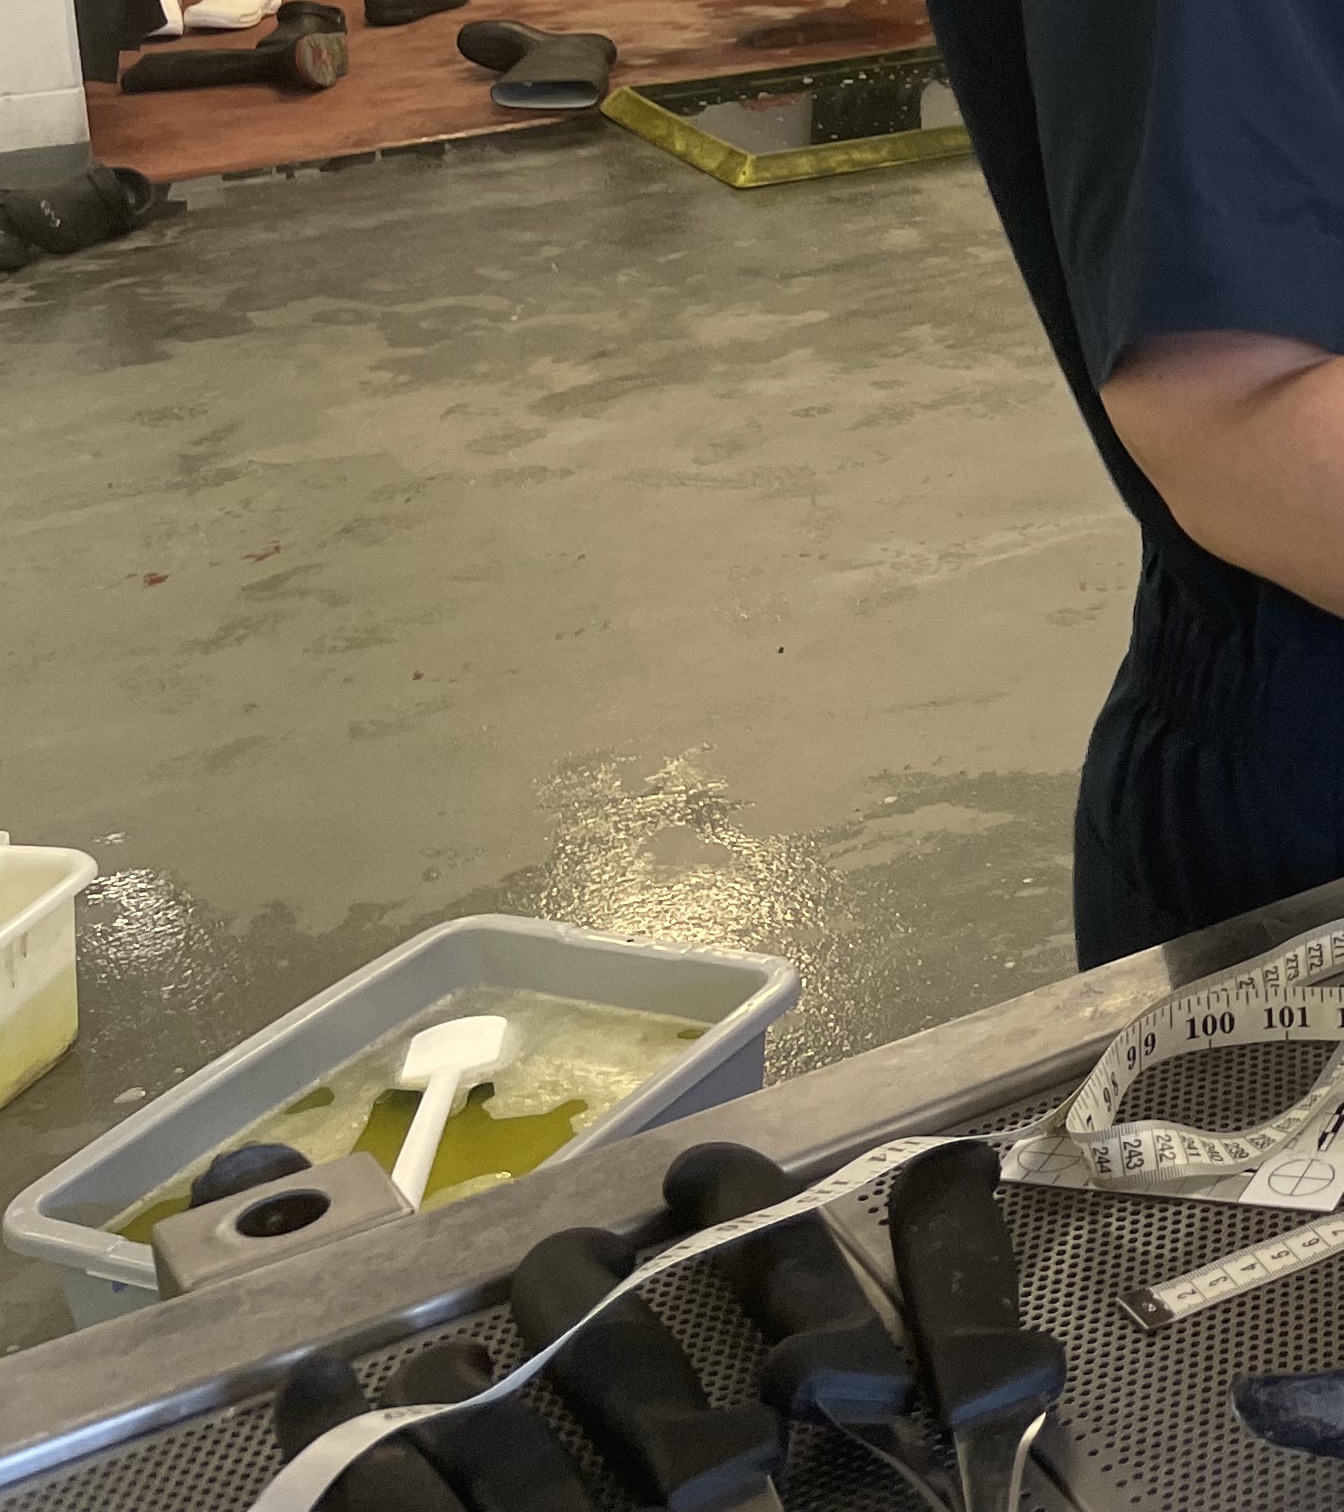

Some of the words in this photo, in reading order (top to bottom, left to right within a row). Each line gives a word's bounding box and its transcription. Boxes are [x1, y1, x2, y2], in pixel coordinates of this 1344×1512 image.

[1287, 953, 1299, 982] 273
[1309, 943, 1323, 971] 272
[1186, 1011, 1236, 1040] 100
[1263, 1006, 1311, 1030] 101
[1092, 1146, 1112, 1175] 244
[1122, 1138, 1145, 1171] 243
[1155, 1133, 1177, 1164] 242
[1182, 1135, 1202, 1158] 241
[1177, 1287, 1198, 1301] 2
[1208, 1275, 1229, 1288] 3
[1239, 1261, 1259, 1273] 4
[1270, 1249, 1291, 1261] 5
[1302, 1237, 1321, 1249] 6
